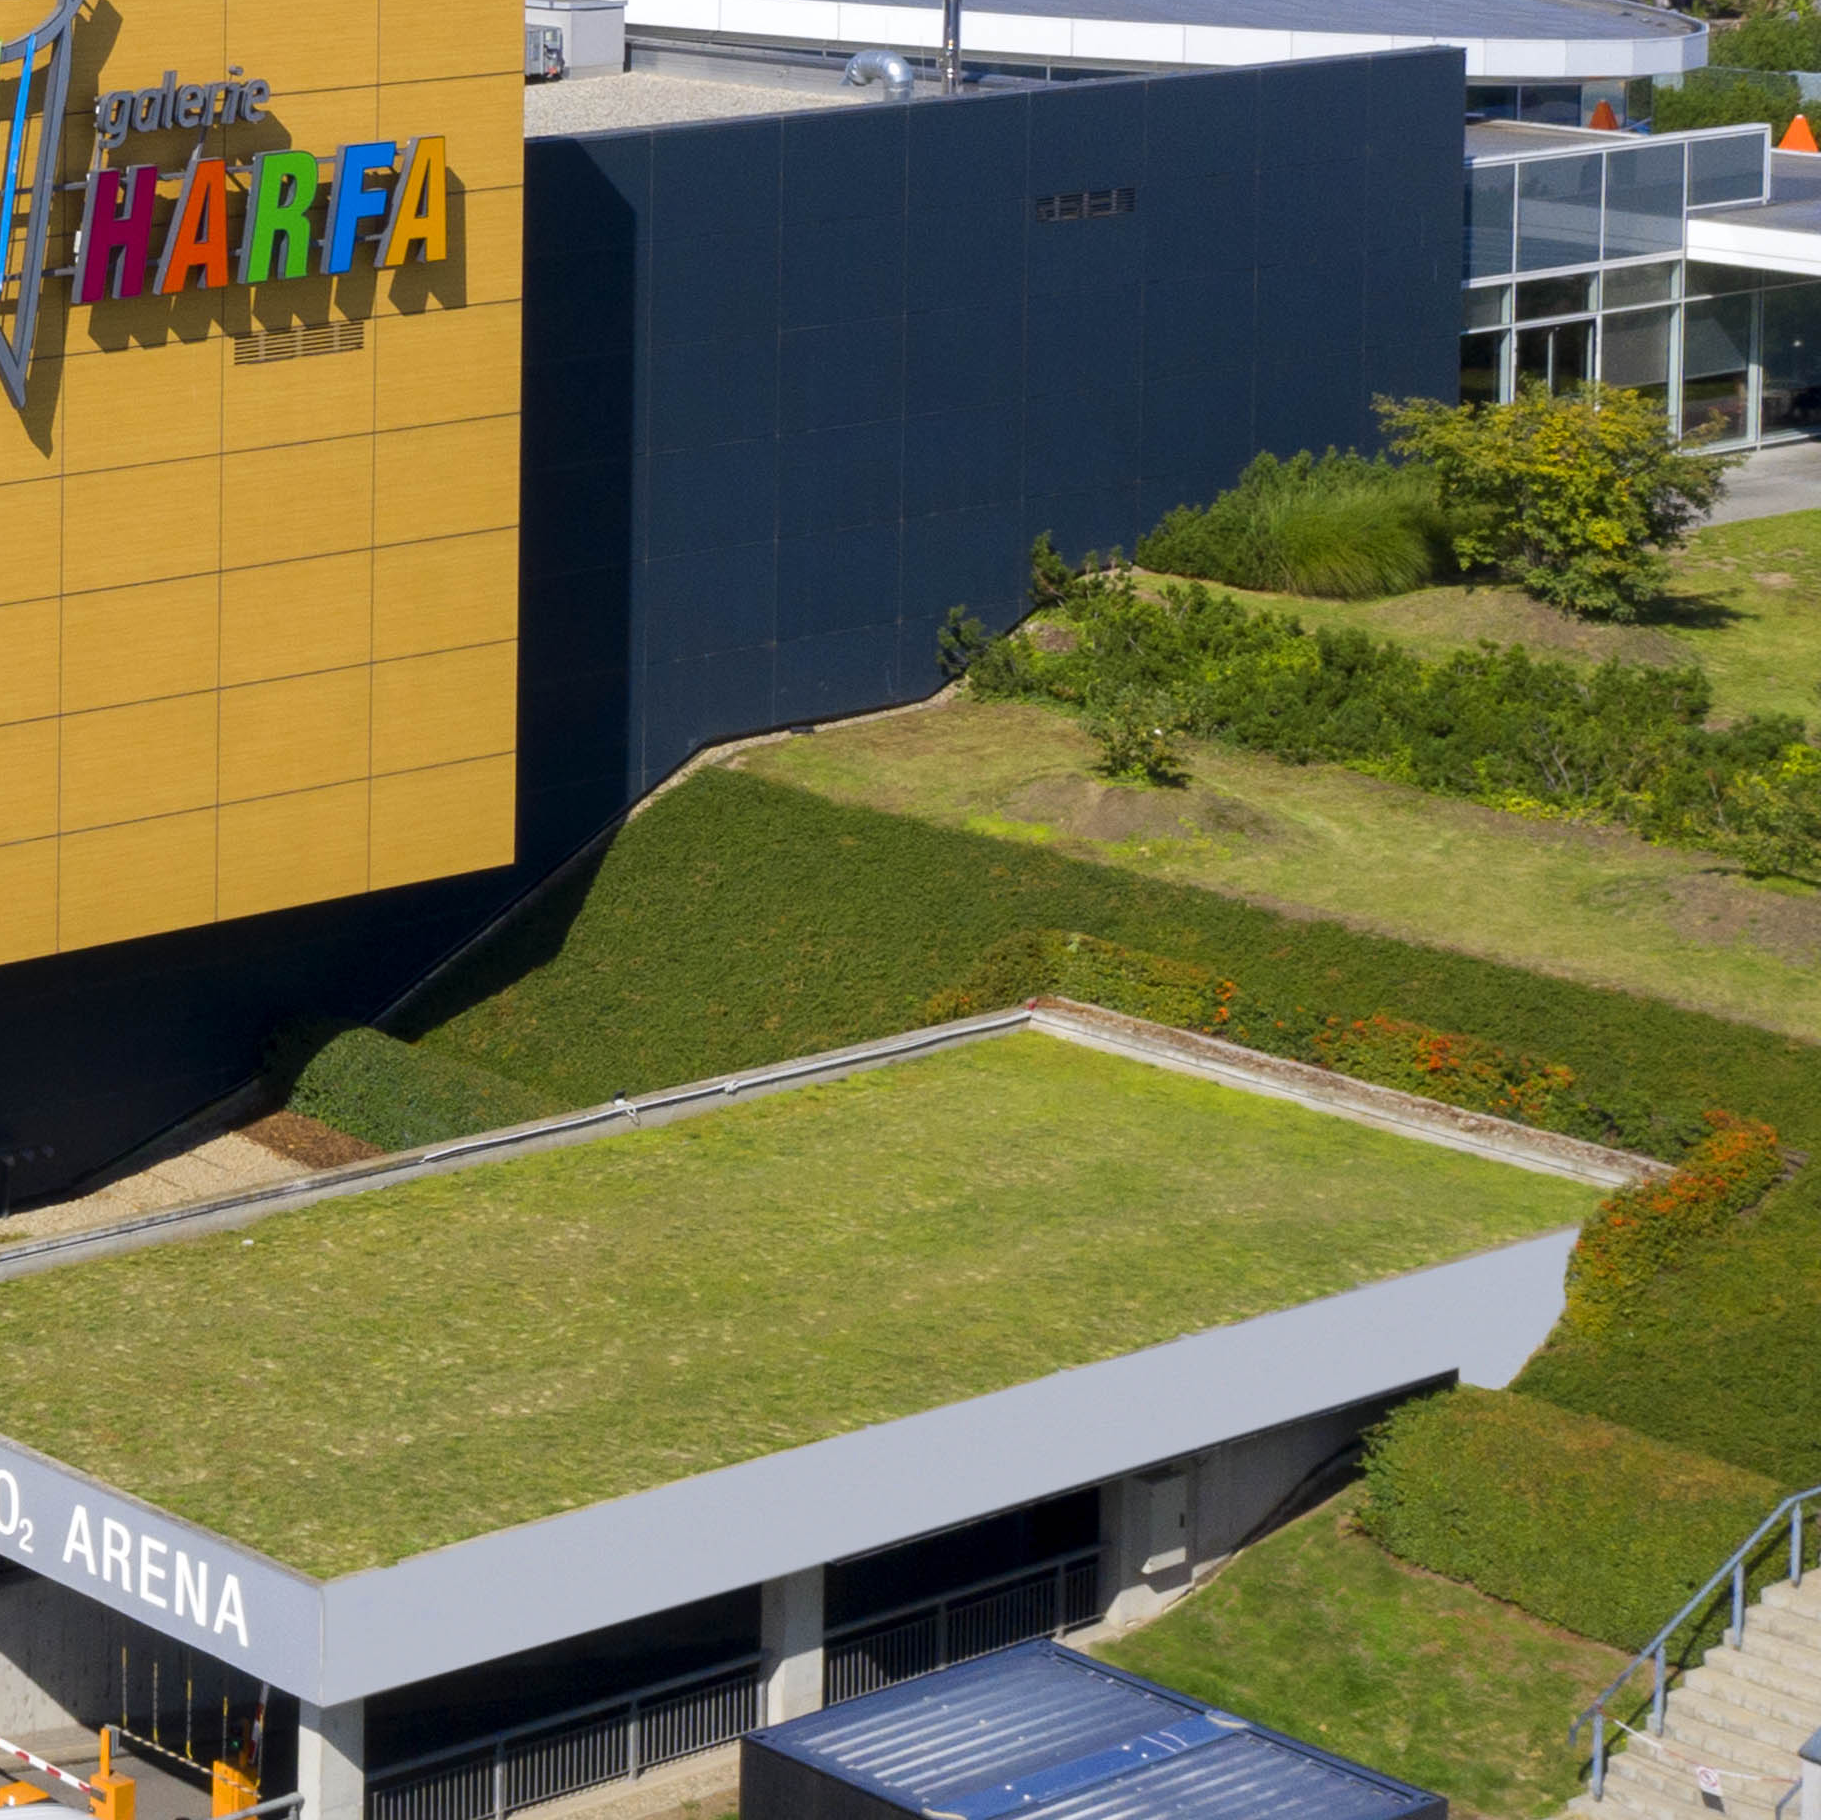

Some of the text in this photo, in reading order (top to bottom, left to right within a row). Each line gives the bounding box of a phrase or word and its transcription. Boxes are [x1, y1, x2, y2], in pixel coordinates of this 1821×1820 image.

[96, 69, 271, 148] galerie
[71, 135, 448, 303] HARFA
[62, 1504, 250, 1647] ARENA
